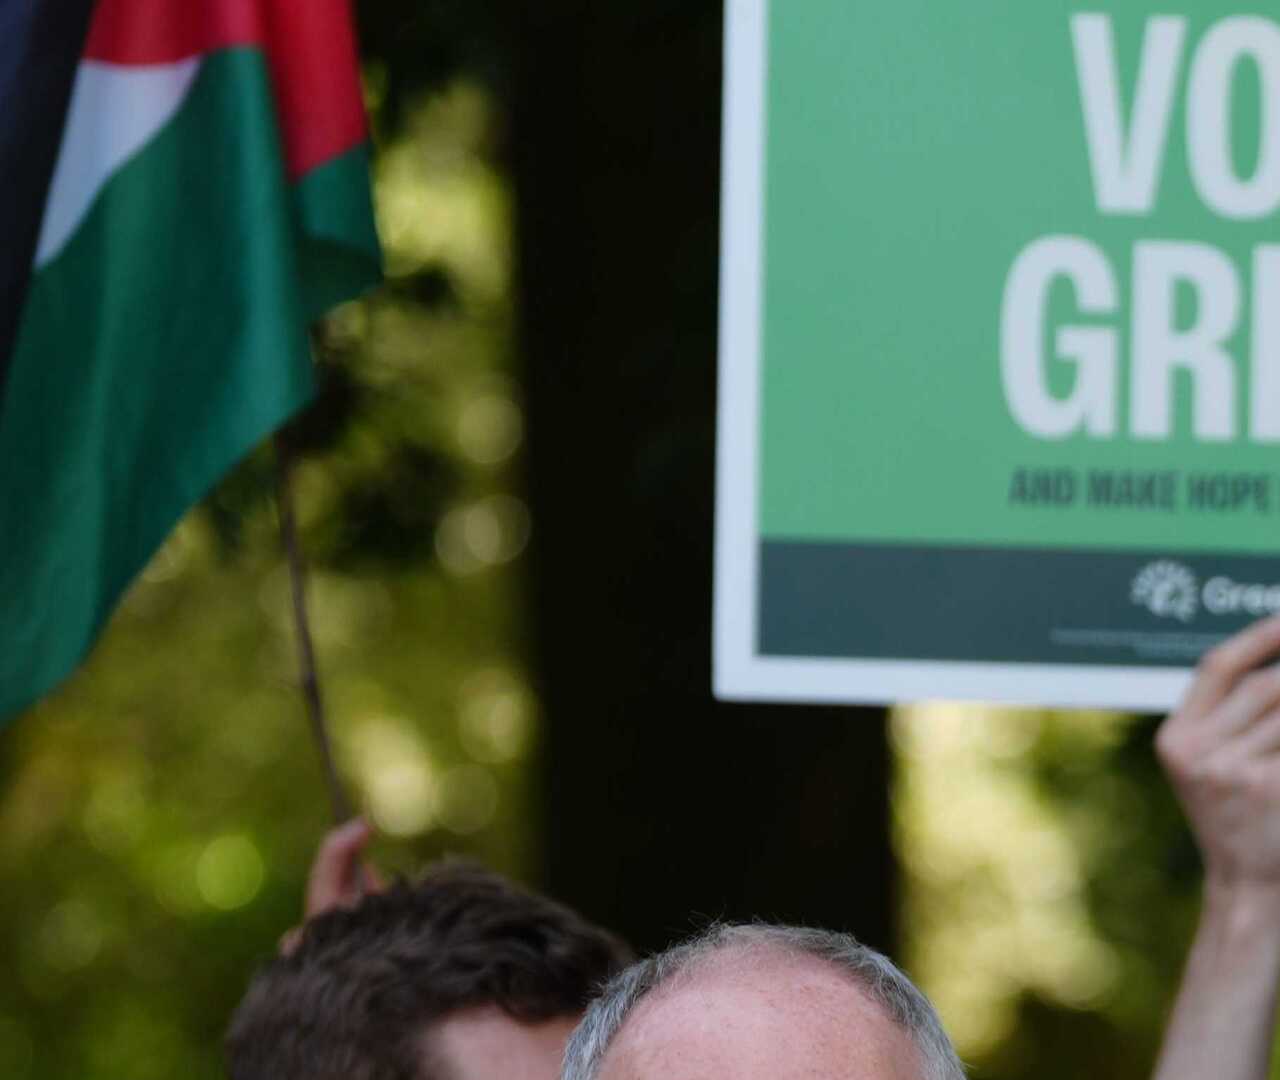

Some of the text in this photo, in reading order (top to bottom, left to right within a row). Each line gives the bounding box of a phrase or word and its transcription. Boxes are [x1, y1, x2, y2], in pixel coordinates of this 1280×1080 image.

[1007, 467, 1077, 508] AND
[1085, 469, 1177, 511] MAKE
[1187, 472, 1270, 514] HOPE
